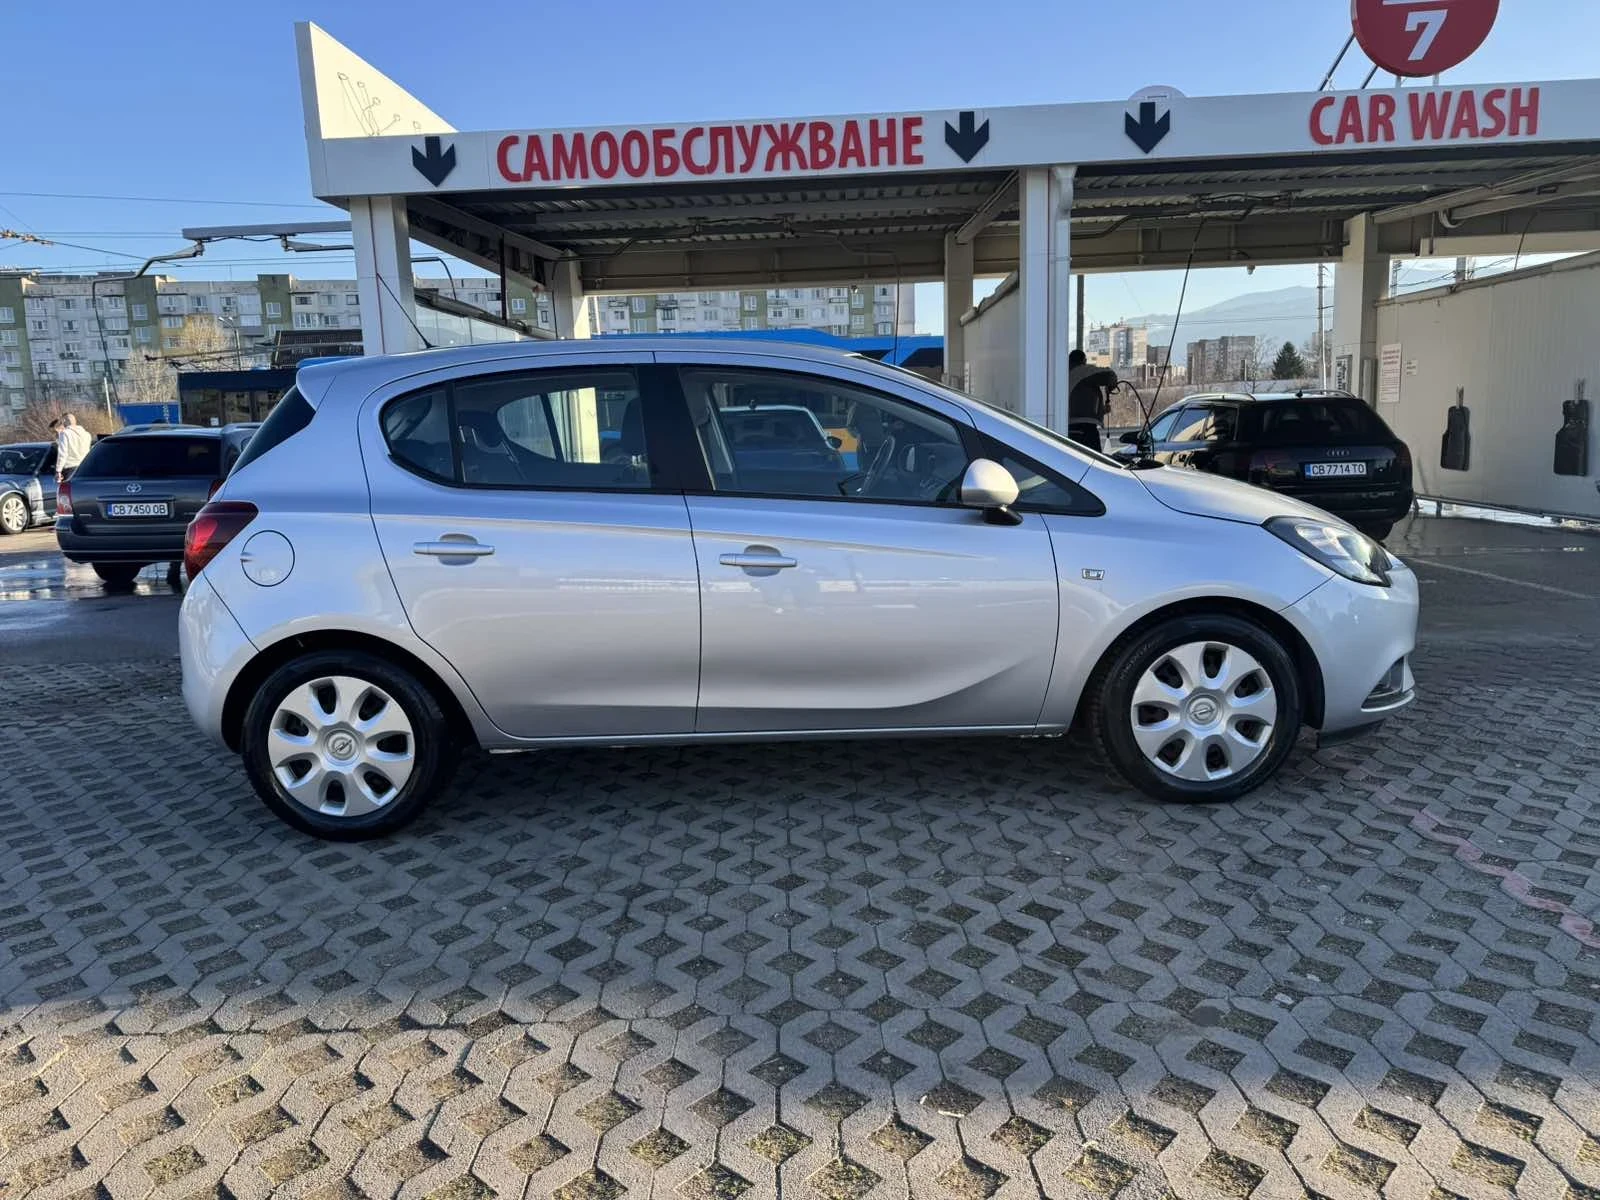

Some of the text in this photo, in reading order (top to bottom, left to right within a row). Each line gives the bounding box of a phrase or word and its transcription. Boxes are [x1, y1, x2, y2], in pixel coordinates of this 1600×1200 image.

[1404, 9, 1449, 61] 7
[1309, 87, 1540, 146] CAR WASH
[496, 116, 924, 183] САМООБСЛУЖВАНЕ
[1327, 464, 1350, 475] 7714
[128, 505, 151, 515] 7450
